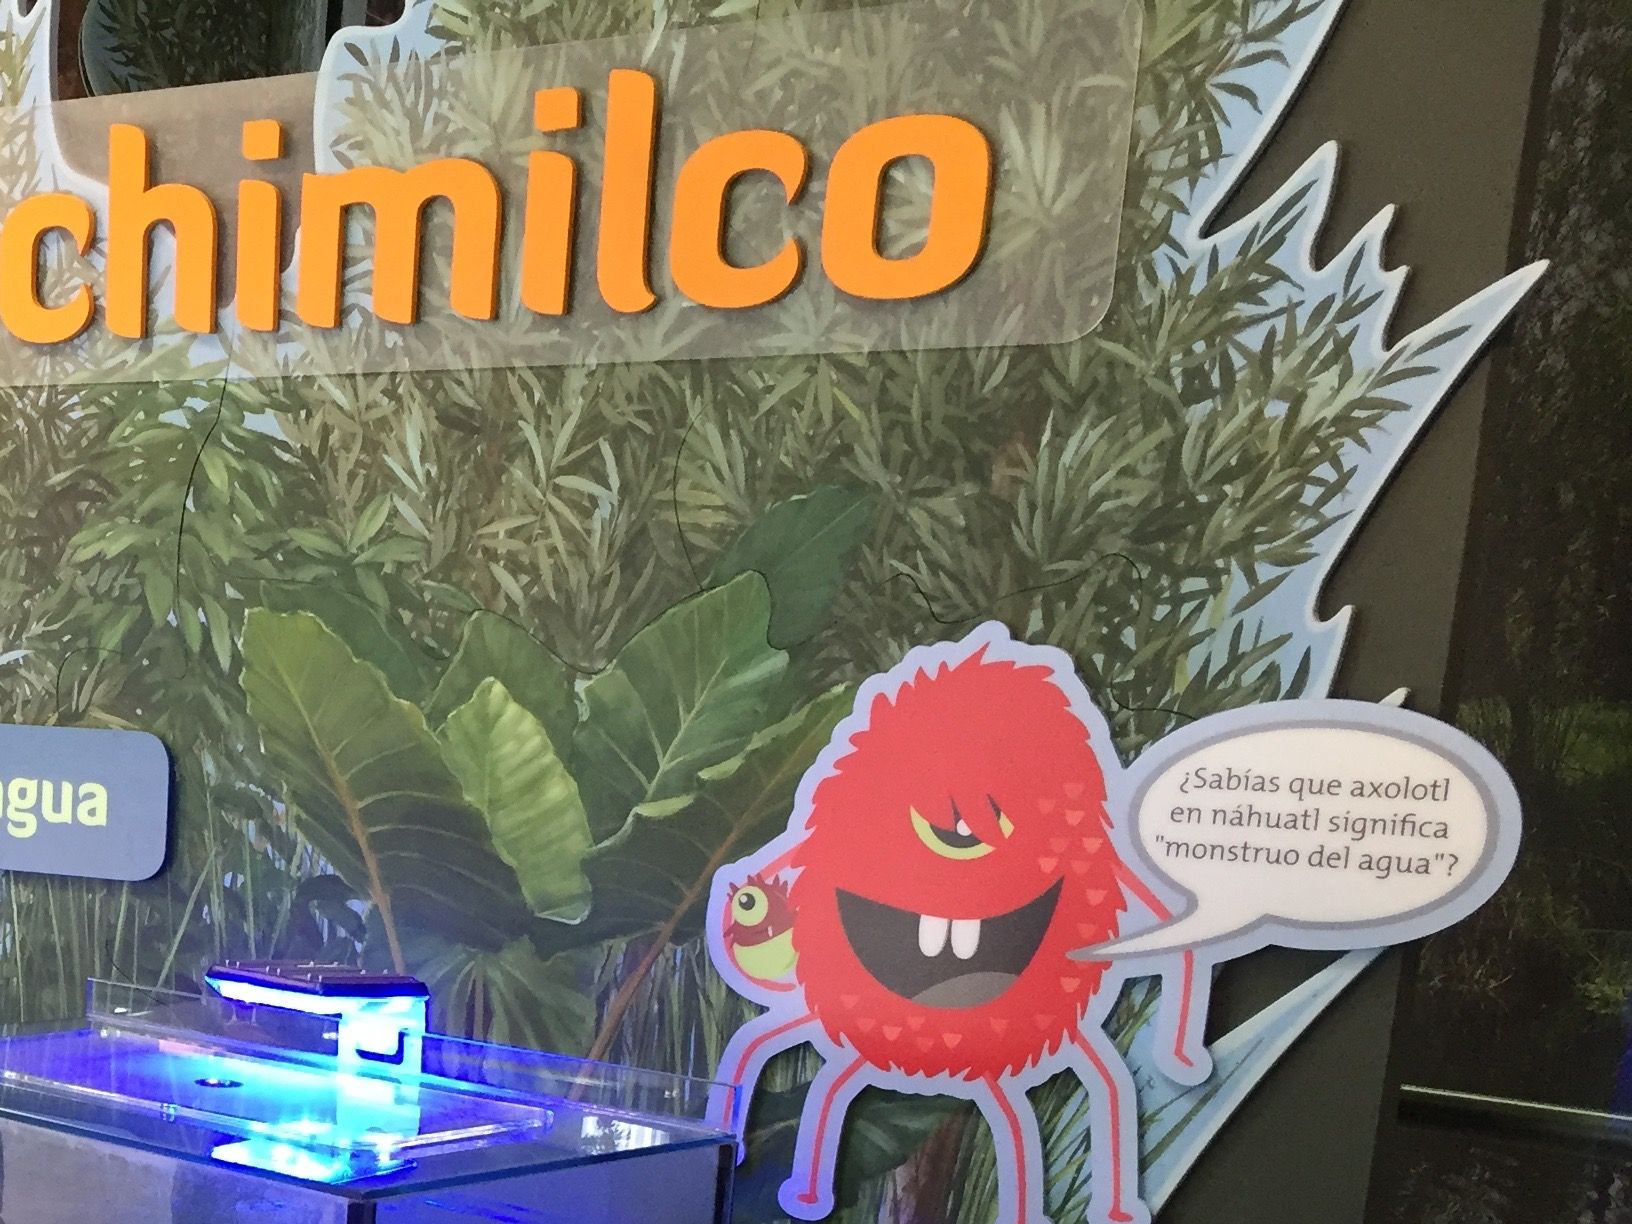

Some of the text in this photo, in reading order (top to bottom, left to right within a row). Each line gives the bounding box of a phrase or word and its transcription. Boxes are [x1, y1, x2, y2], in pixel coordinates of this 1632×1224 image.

[1179, 767, 1450, 802] ¿Sabías que axolotl
[1170, 804, 1449, 842] en náhuatl significa
[1155, 834, 1459, 880] "monstruo del agua"?
